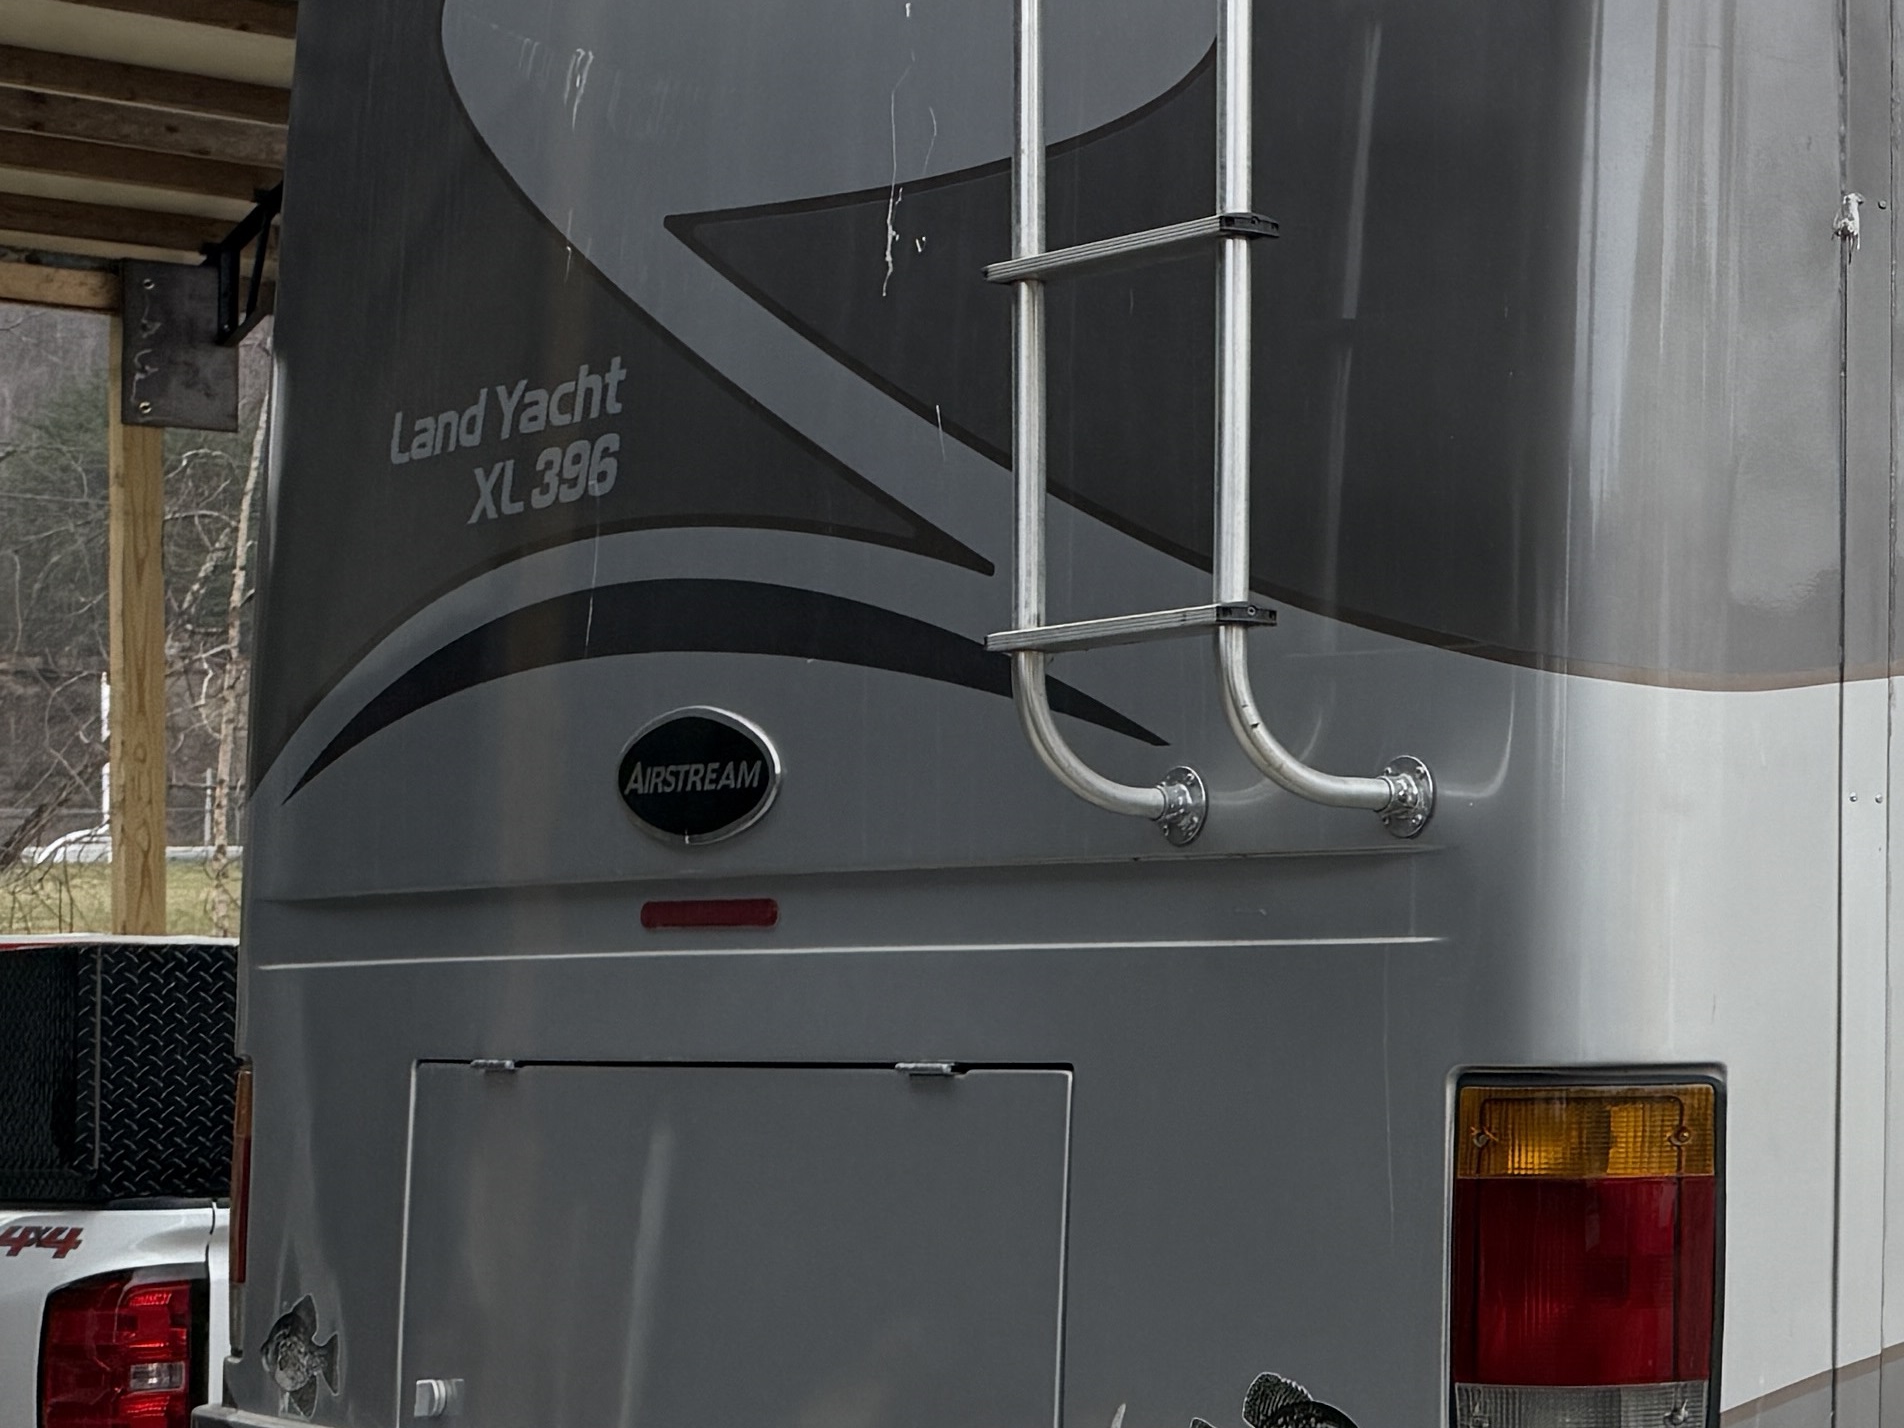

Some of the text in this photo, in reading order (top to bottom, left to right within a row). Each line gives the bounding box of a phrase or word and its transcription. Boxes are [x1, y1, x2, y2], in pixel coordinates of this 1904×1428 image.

[390, 356, 627, 464] Land Yacht
[467, 433, 620, 525] XL 396
[624, 760, 762, 795] AIRSTREAM
